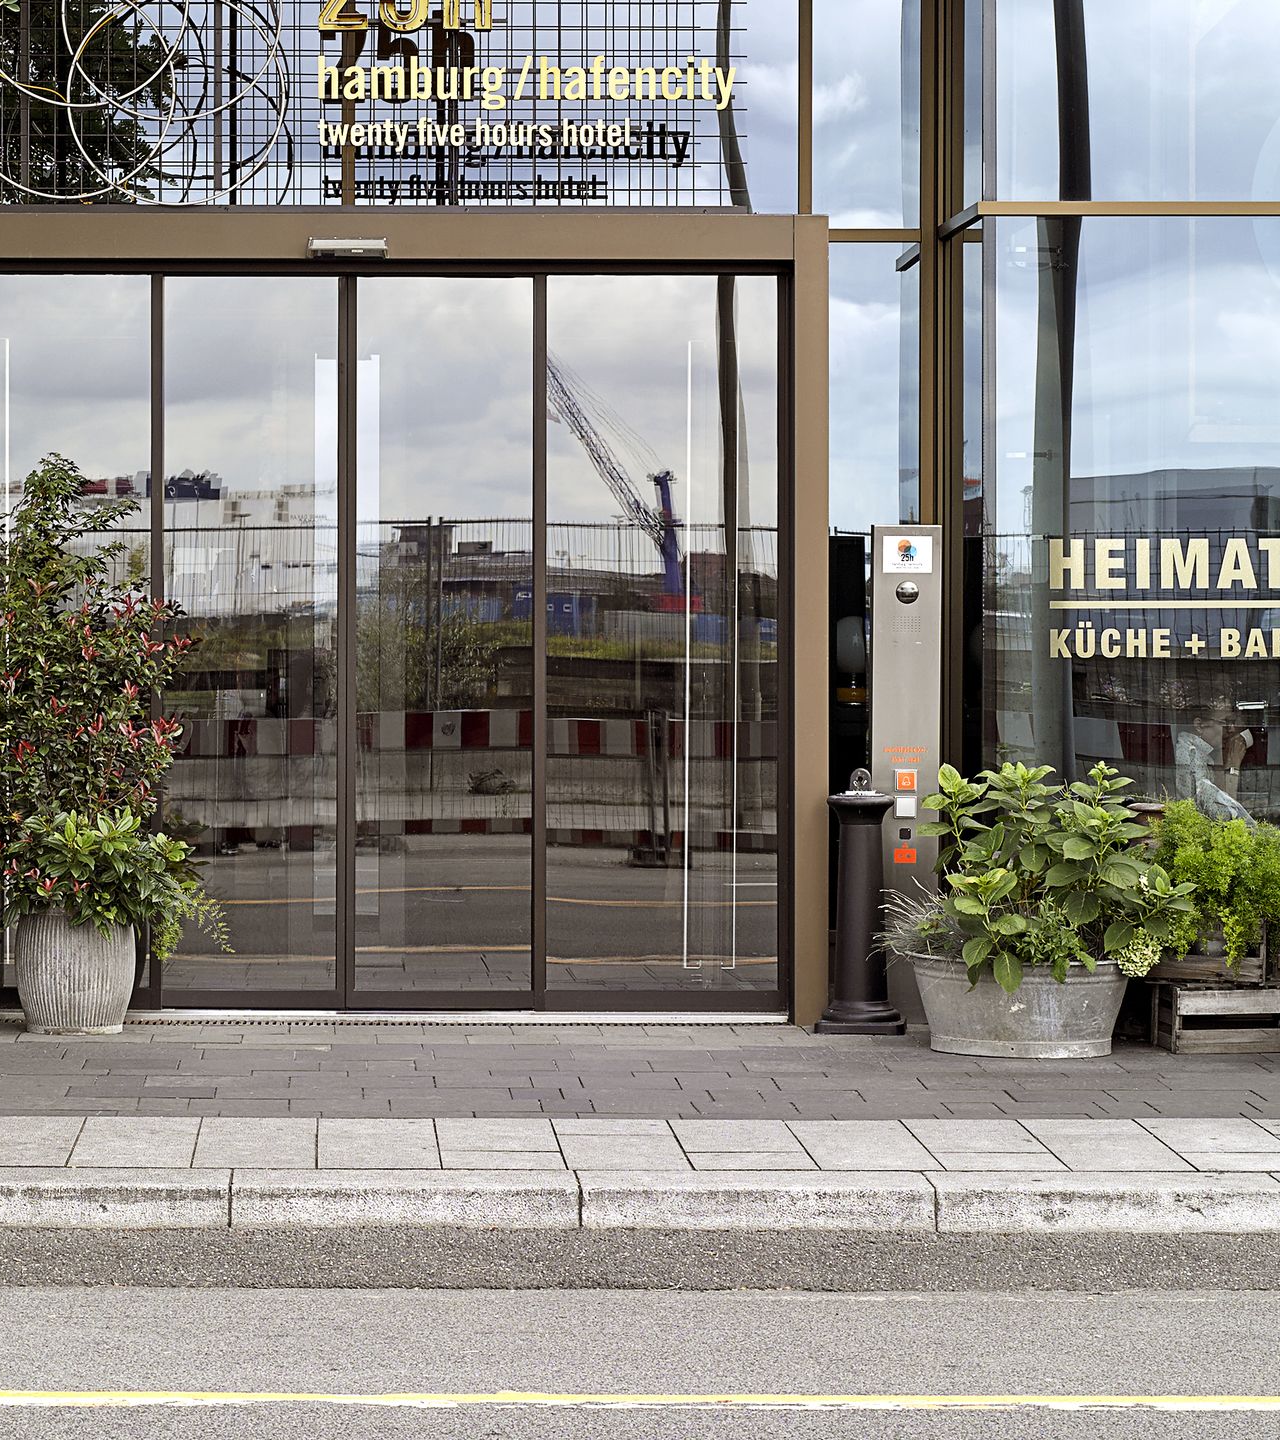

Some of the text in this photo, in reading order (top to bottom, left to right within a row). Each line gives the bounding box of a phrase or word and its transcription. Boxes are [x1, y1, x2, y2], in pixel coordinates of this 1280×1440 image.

[318, 116, 409, 152] twenty
[417, 116, 465, 147] five
[475, 117, 552, 148] hours
[562, 117, 631, 148] hotel
[901, 553, 914, 562] 25h
[1049, 621, 1170, 659] KÜCHE
[1185, 633, 1206, 655] +
